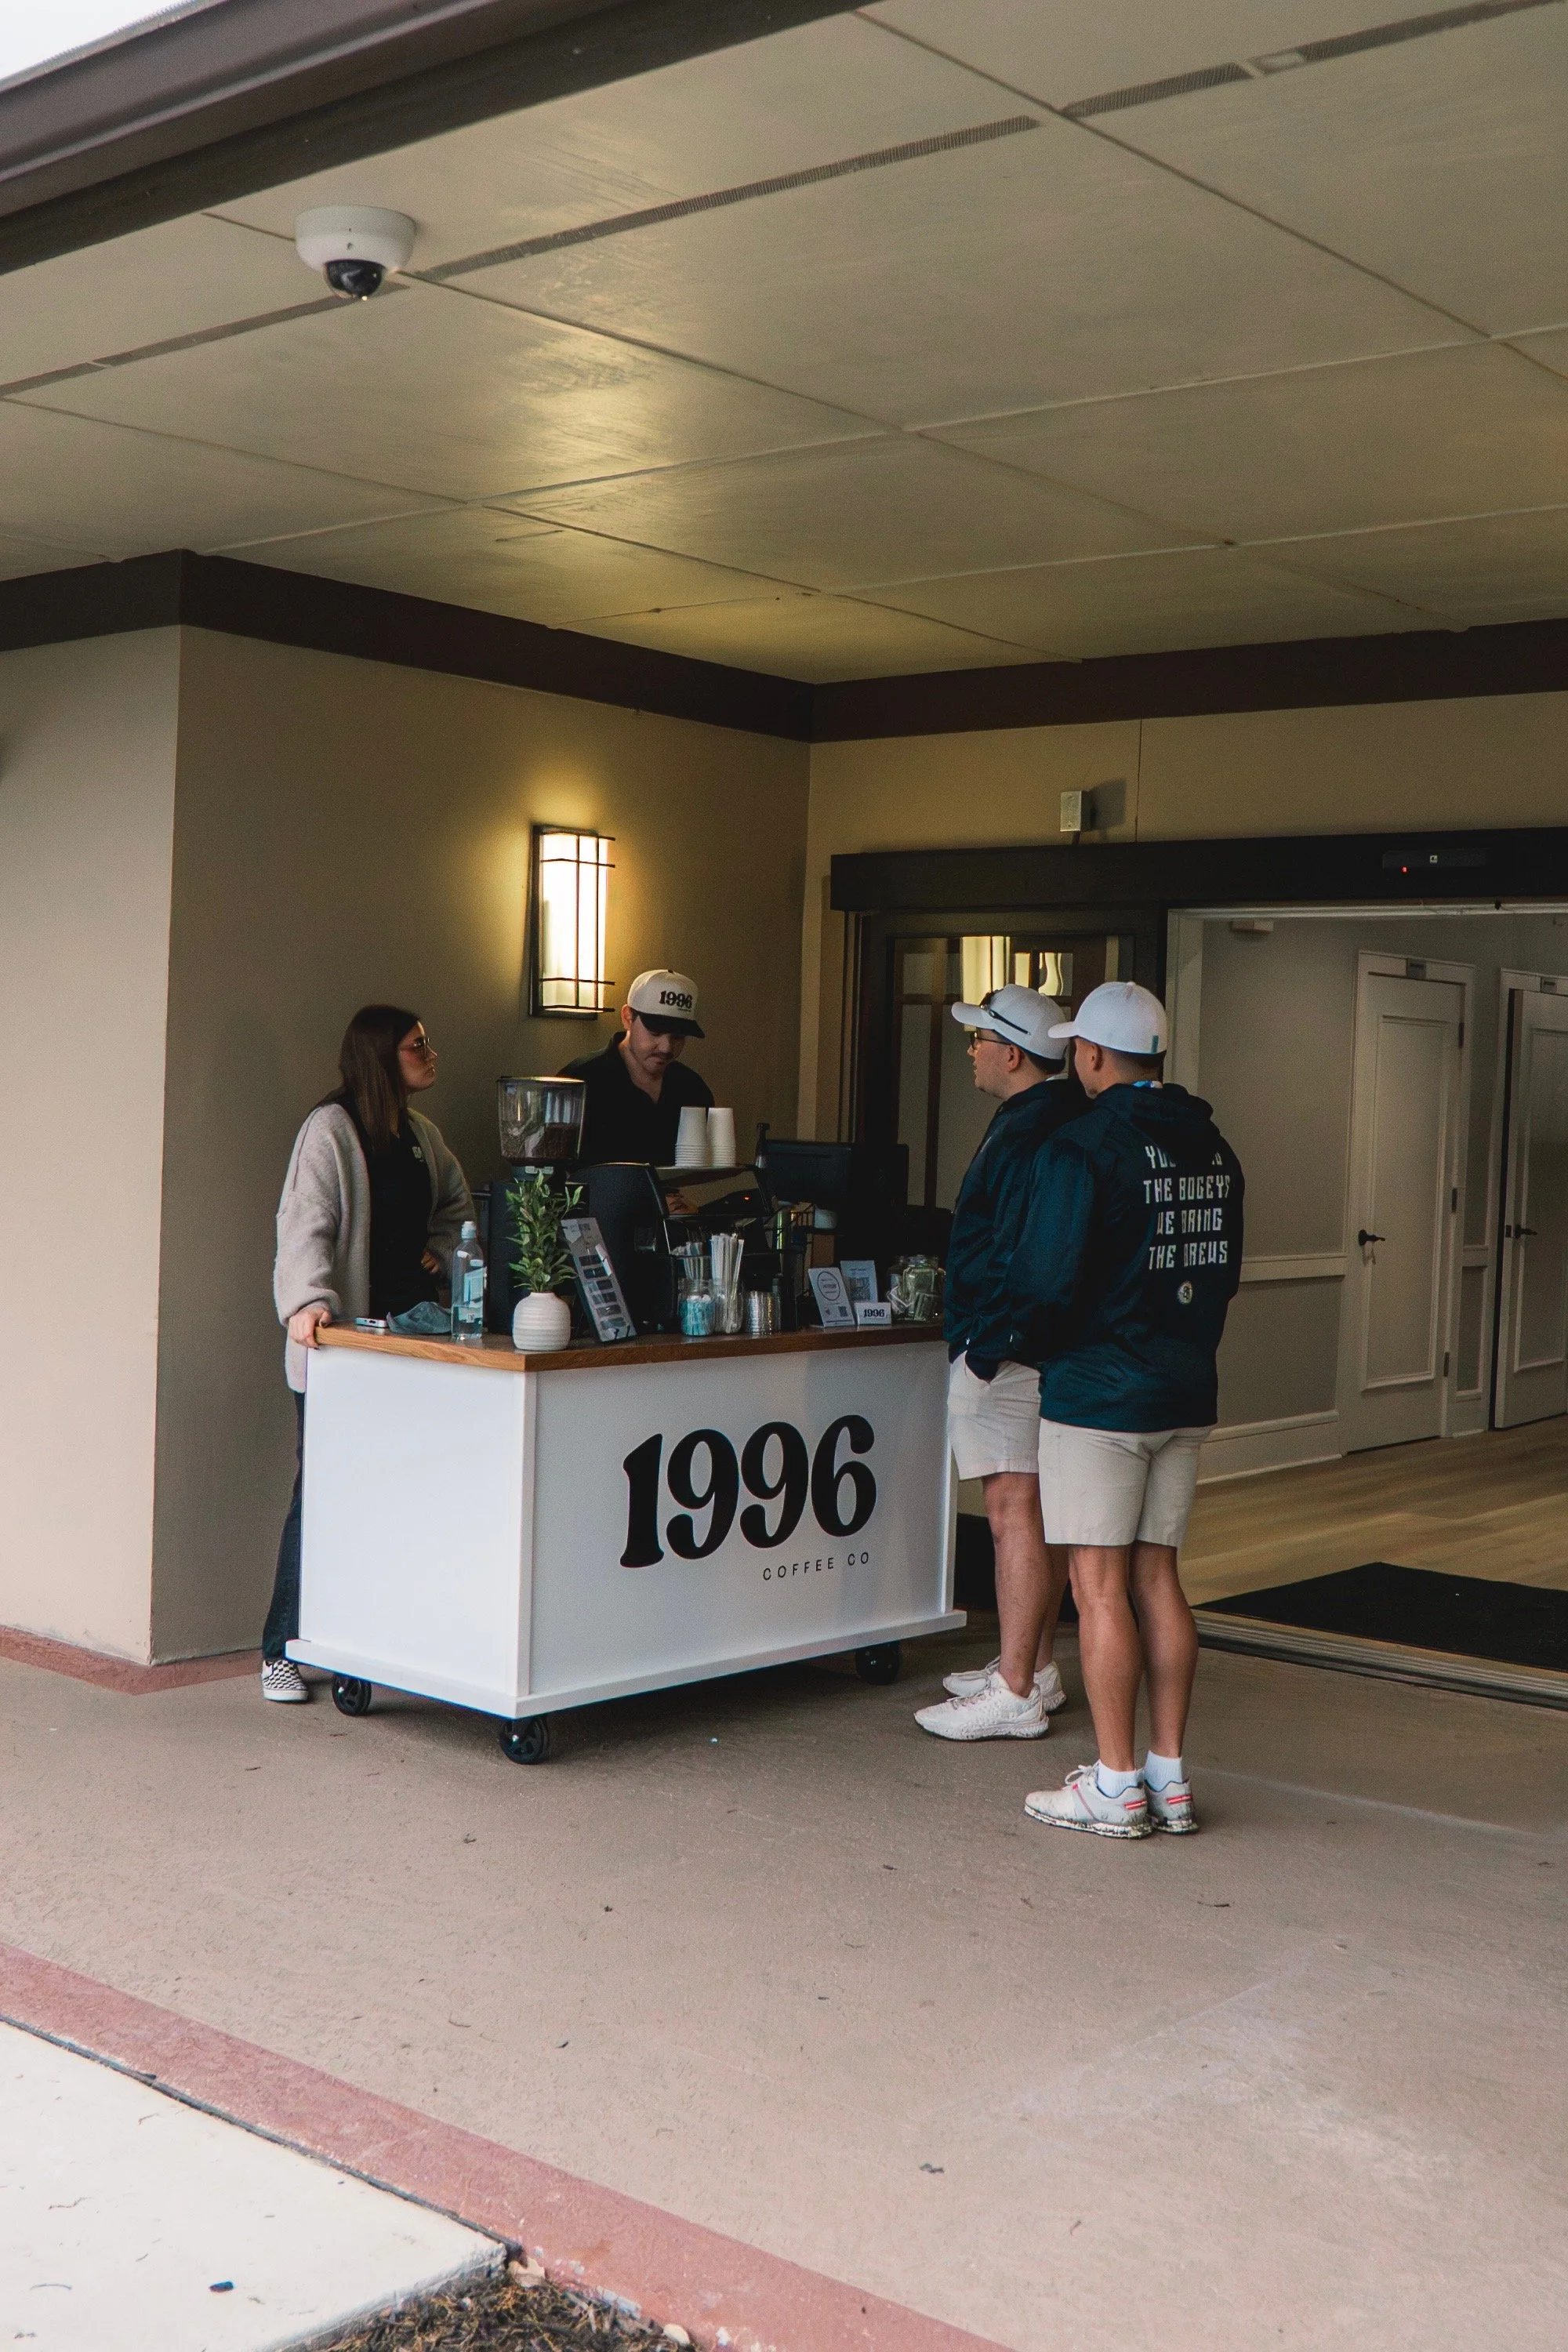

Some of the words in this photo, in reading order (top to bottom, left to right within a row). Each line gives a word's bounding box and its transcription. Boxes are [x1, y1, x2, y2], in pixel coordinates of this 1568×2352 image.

[659, 990, 693, 1008] 1996
[1143, 1178, 1173, 1203] THE
[1179, 1174, 1230, 1201] BOGEYS
[1156, 1210, 1175, 1235] WE
[1149, 1244, 1177, 1270] THE
[863, 1308, 885, 1318] 1996
[619, 1414, 877, 1568] 1996
[763, 1557, 835, 1581] COFFEE
[848, 1552, 870, 1566] CO
